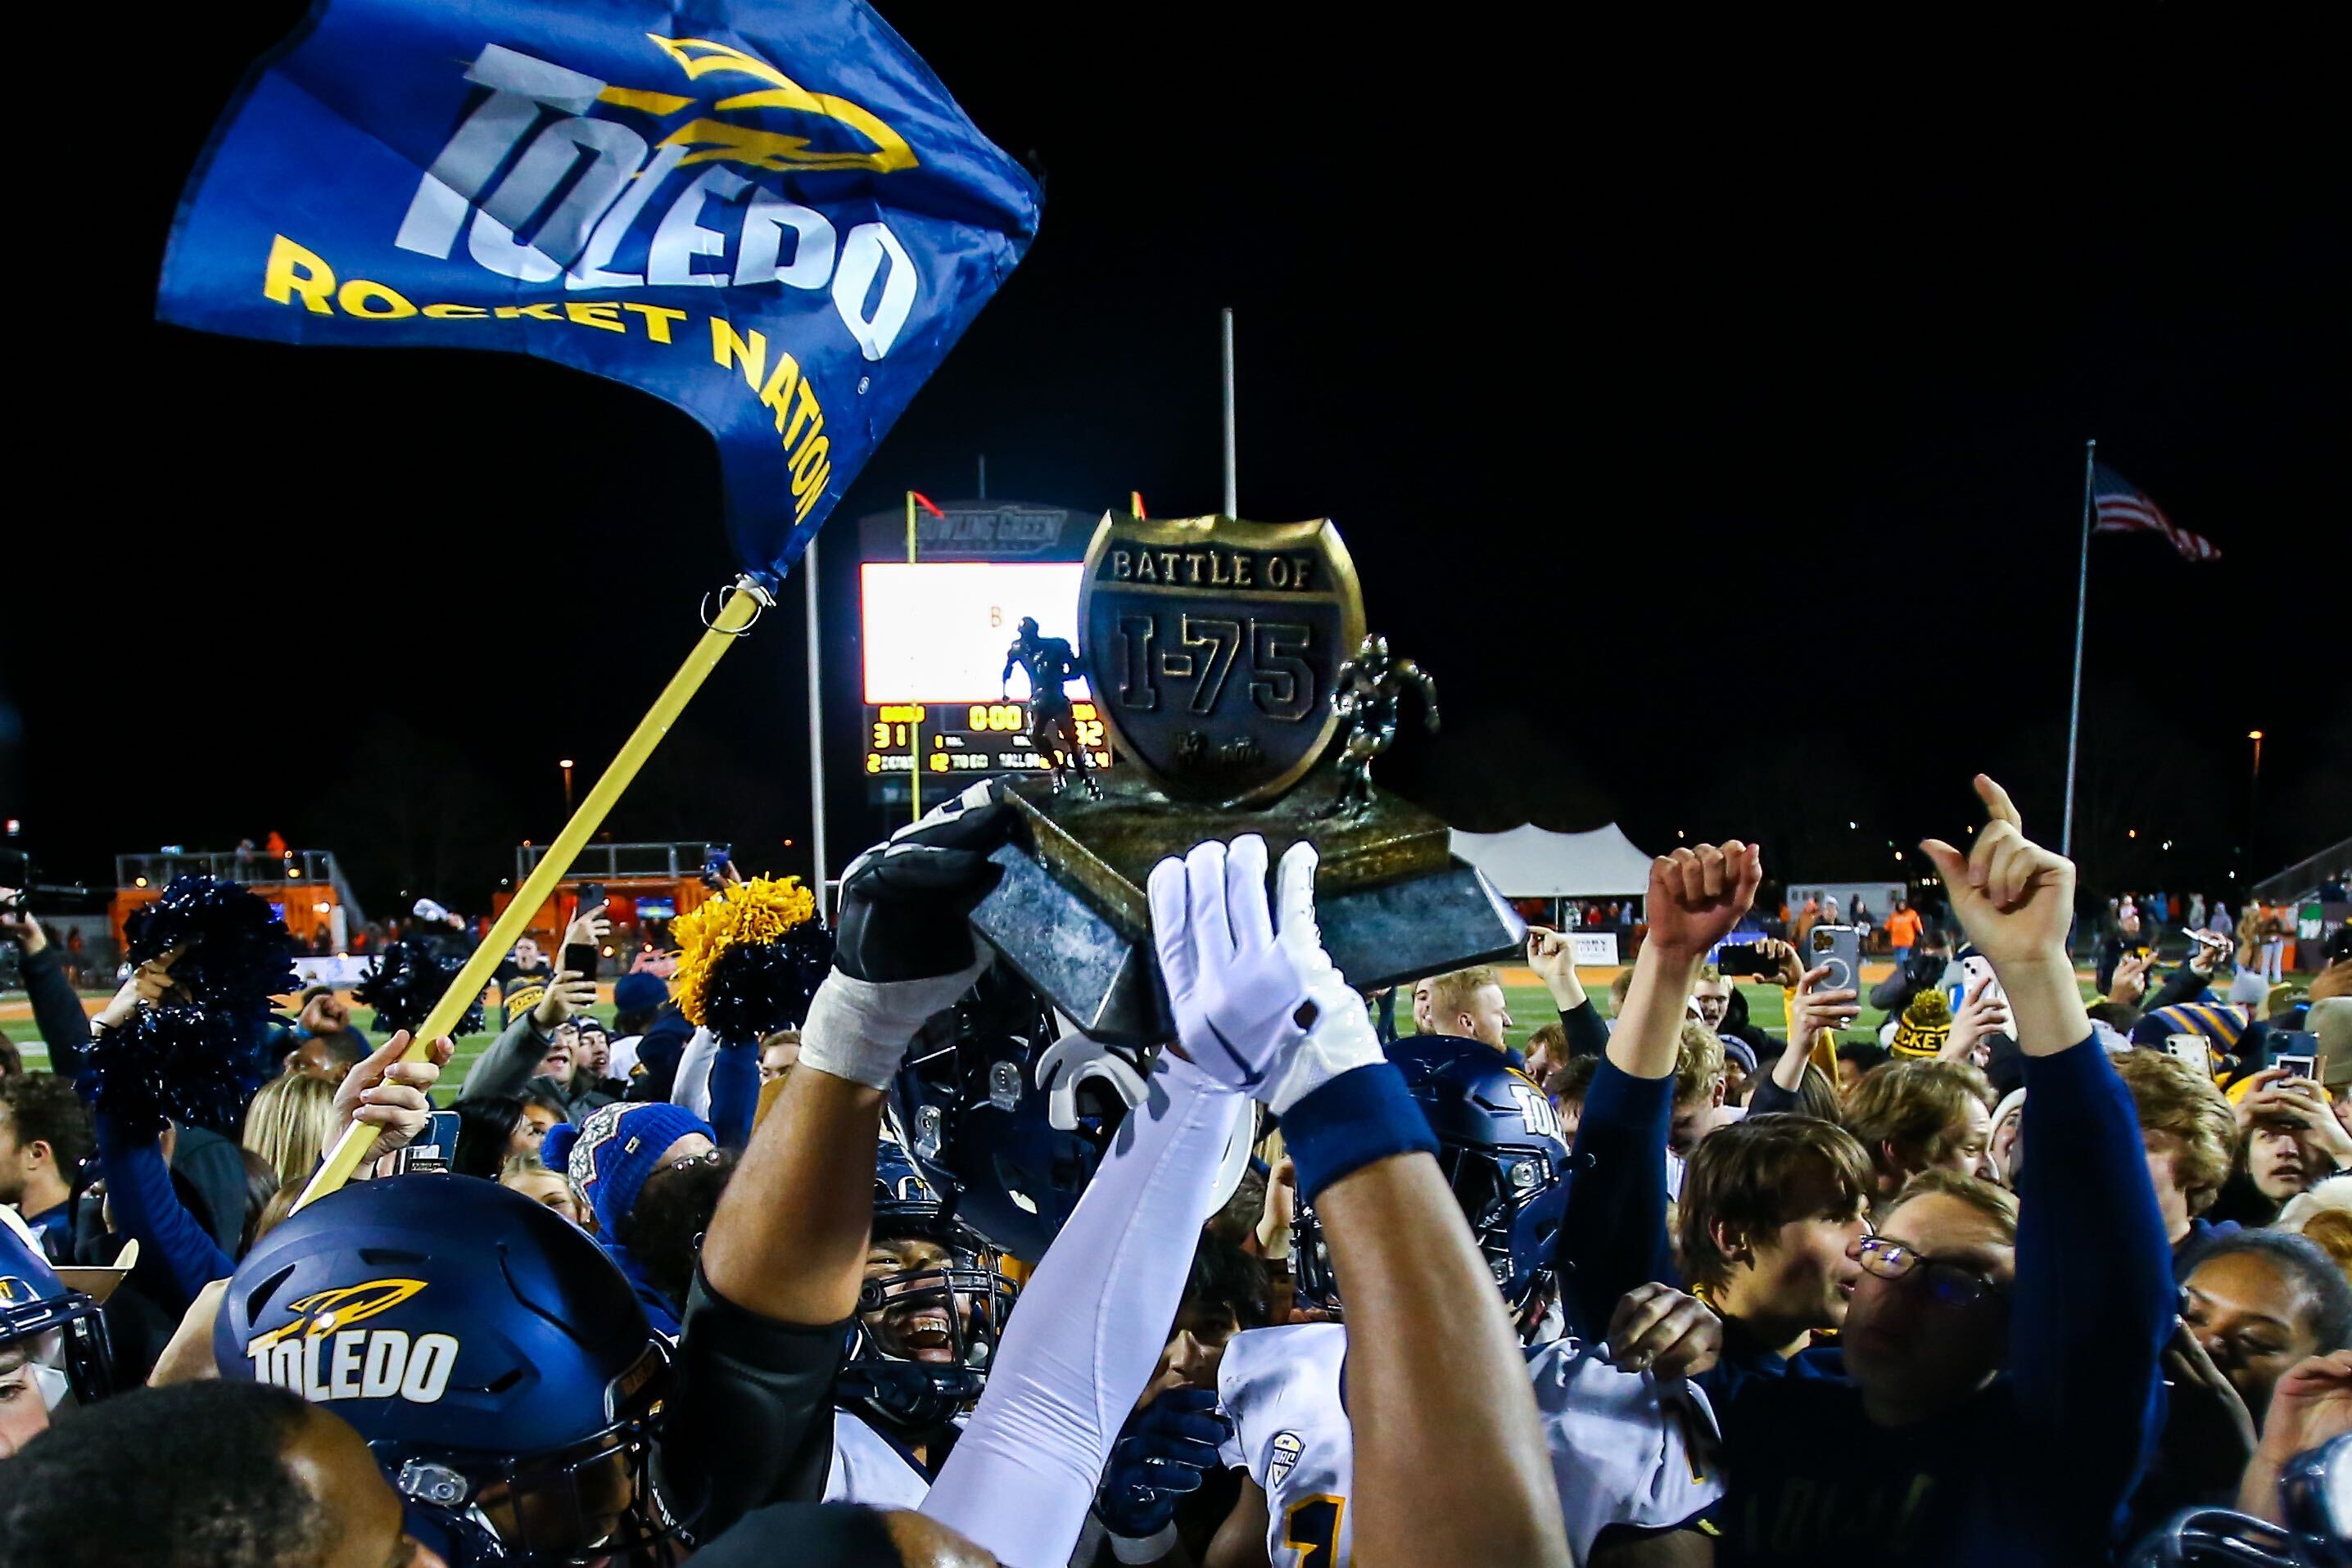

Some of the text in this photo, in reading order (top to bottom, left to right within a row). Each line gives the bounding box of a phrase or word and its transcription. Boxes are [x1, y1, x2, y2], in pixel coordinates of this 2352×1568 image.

[395, 43, 918, 360] TOLEDO
[264, 233, 832, 526] ROCKET NATION
[1112, 549, 1310, 589] BATTLE OF
[1119, 612, 1314, 722] I-75
[247, 1330, 459, 1403] TOLEDO
